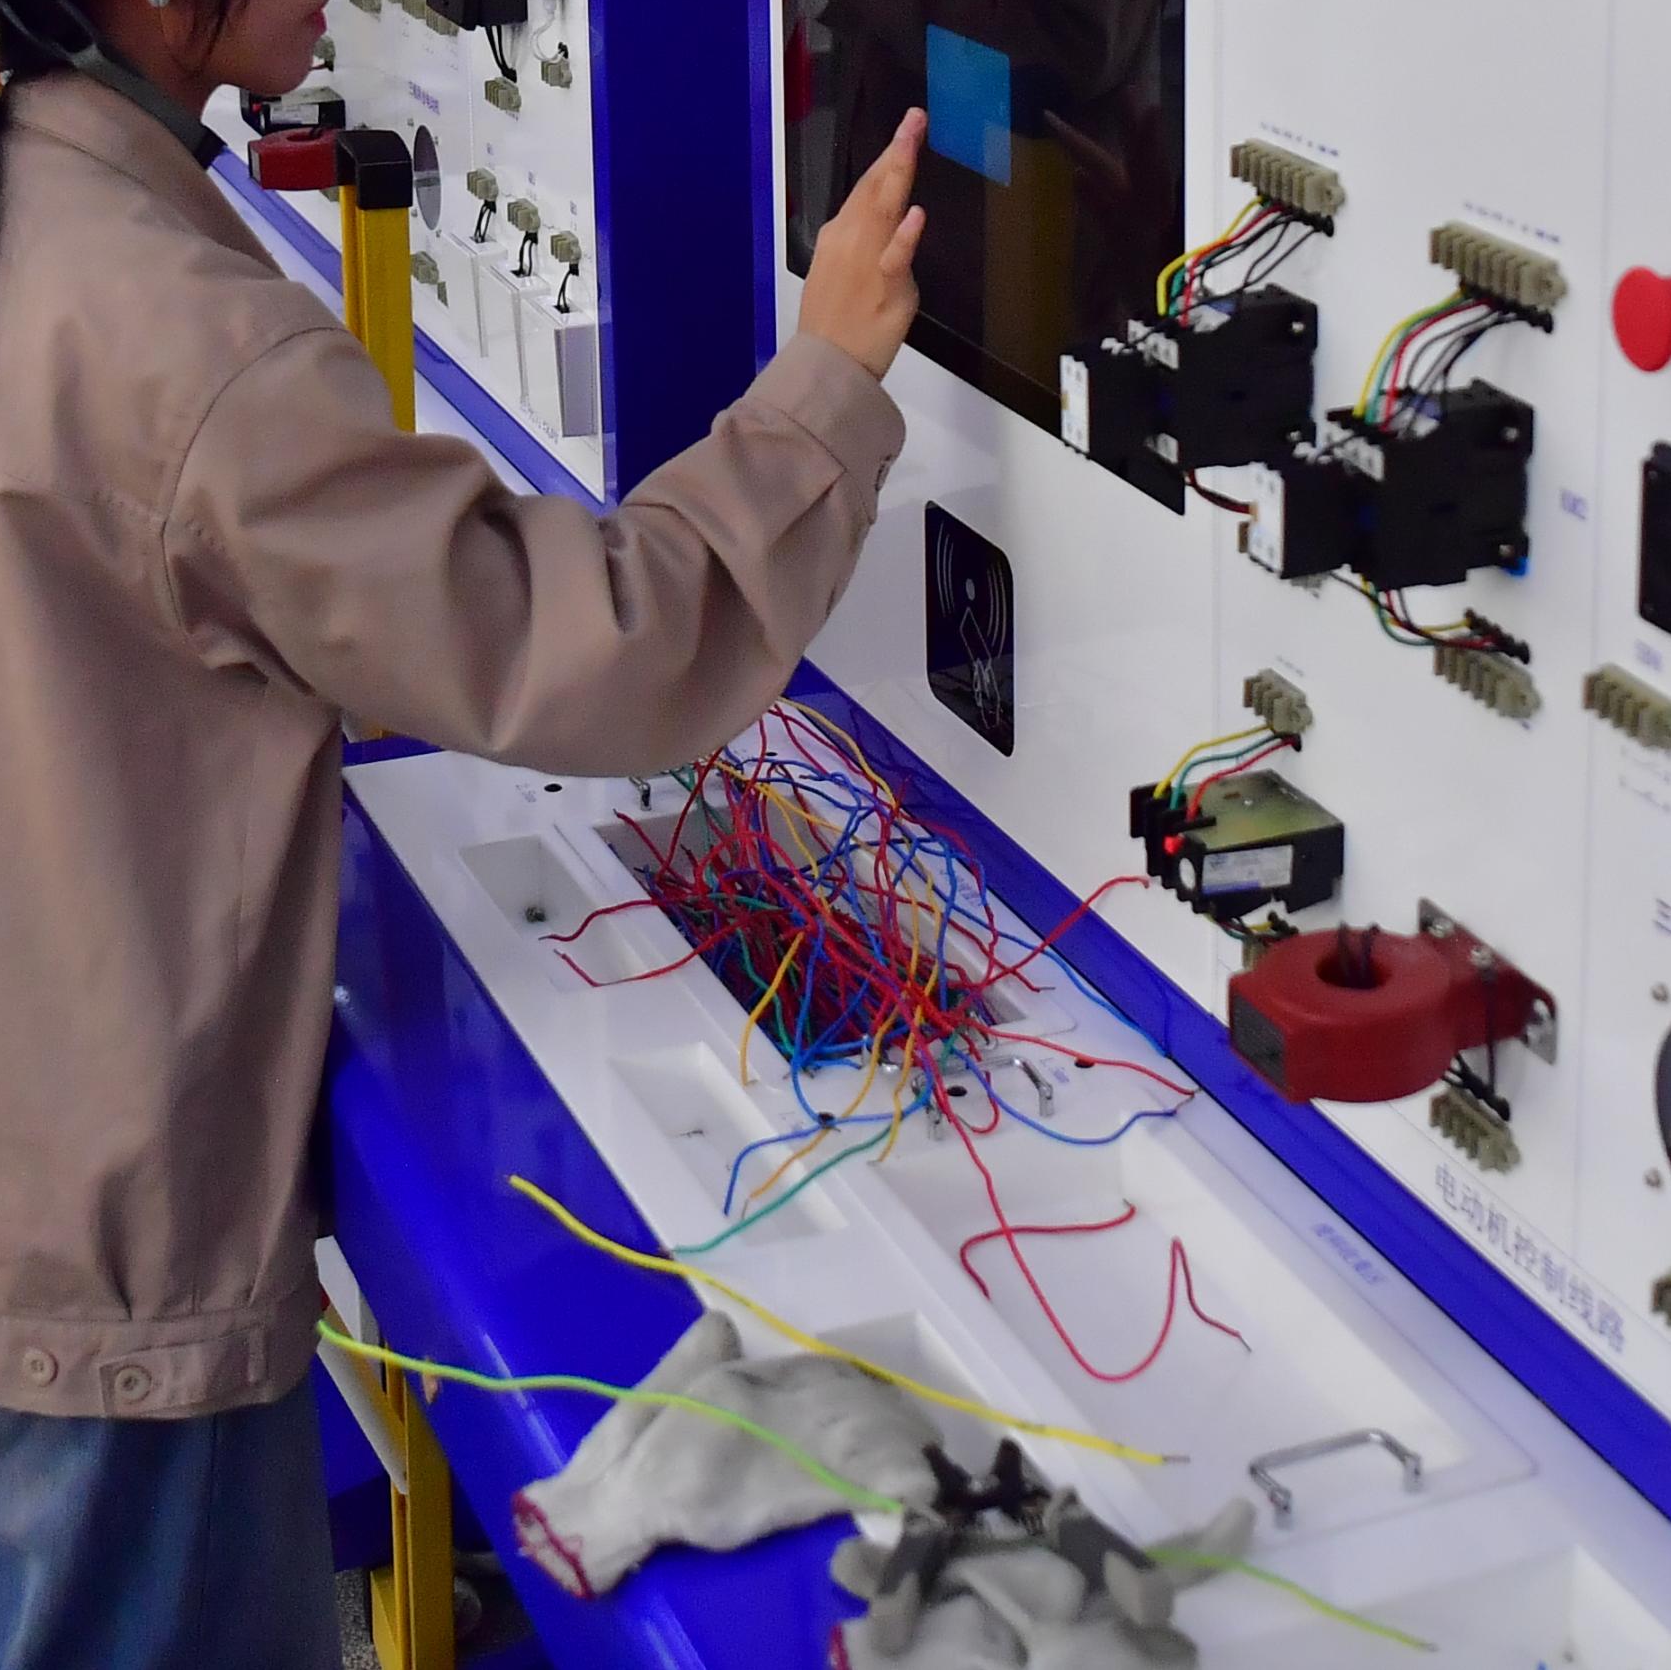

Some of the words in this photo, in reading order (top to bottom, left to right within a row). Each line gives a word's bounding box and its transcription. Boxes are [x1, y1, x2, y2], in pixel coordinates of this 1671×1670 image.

[1435, 1162, 1626, 1354] 电动机控制线路
